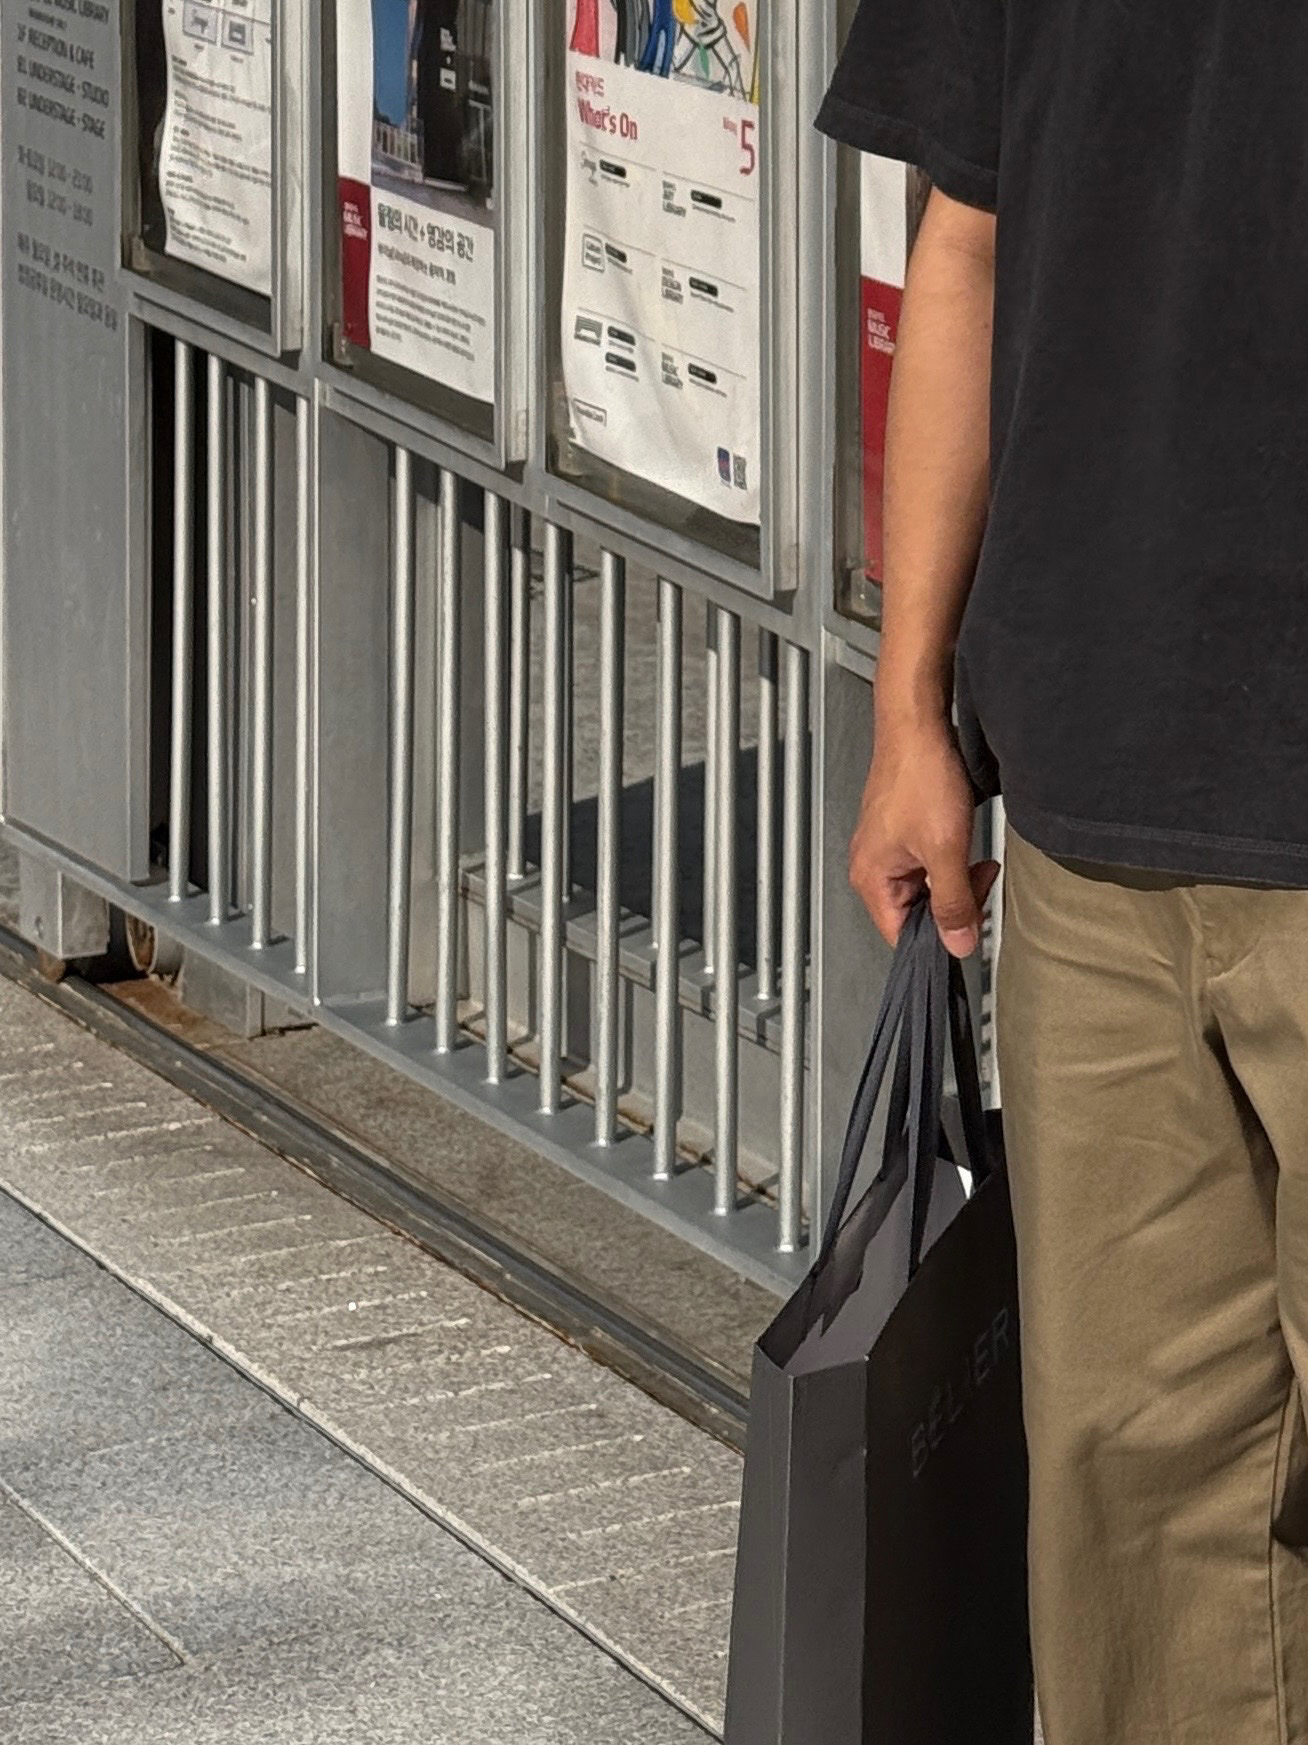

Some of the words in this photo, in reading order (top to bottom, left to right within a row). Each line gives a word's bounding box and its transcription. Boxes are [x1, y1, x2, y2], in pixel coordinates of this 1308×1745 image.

[578, 97, 617, 135] What's
[619, 112, 638, 141] On
[739, 119, 755, 176] 5
[456, 230, 474, 264] 공간
